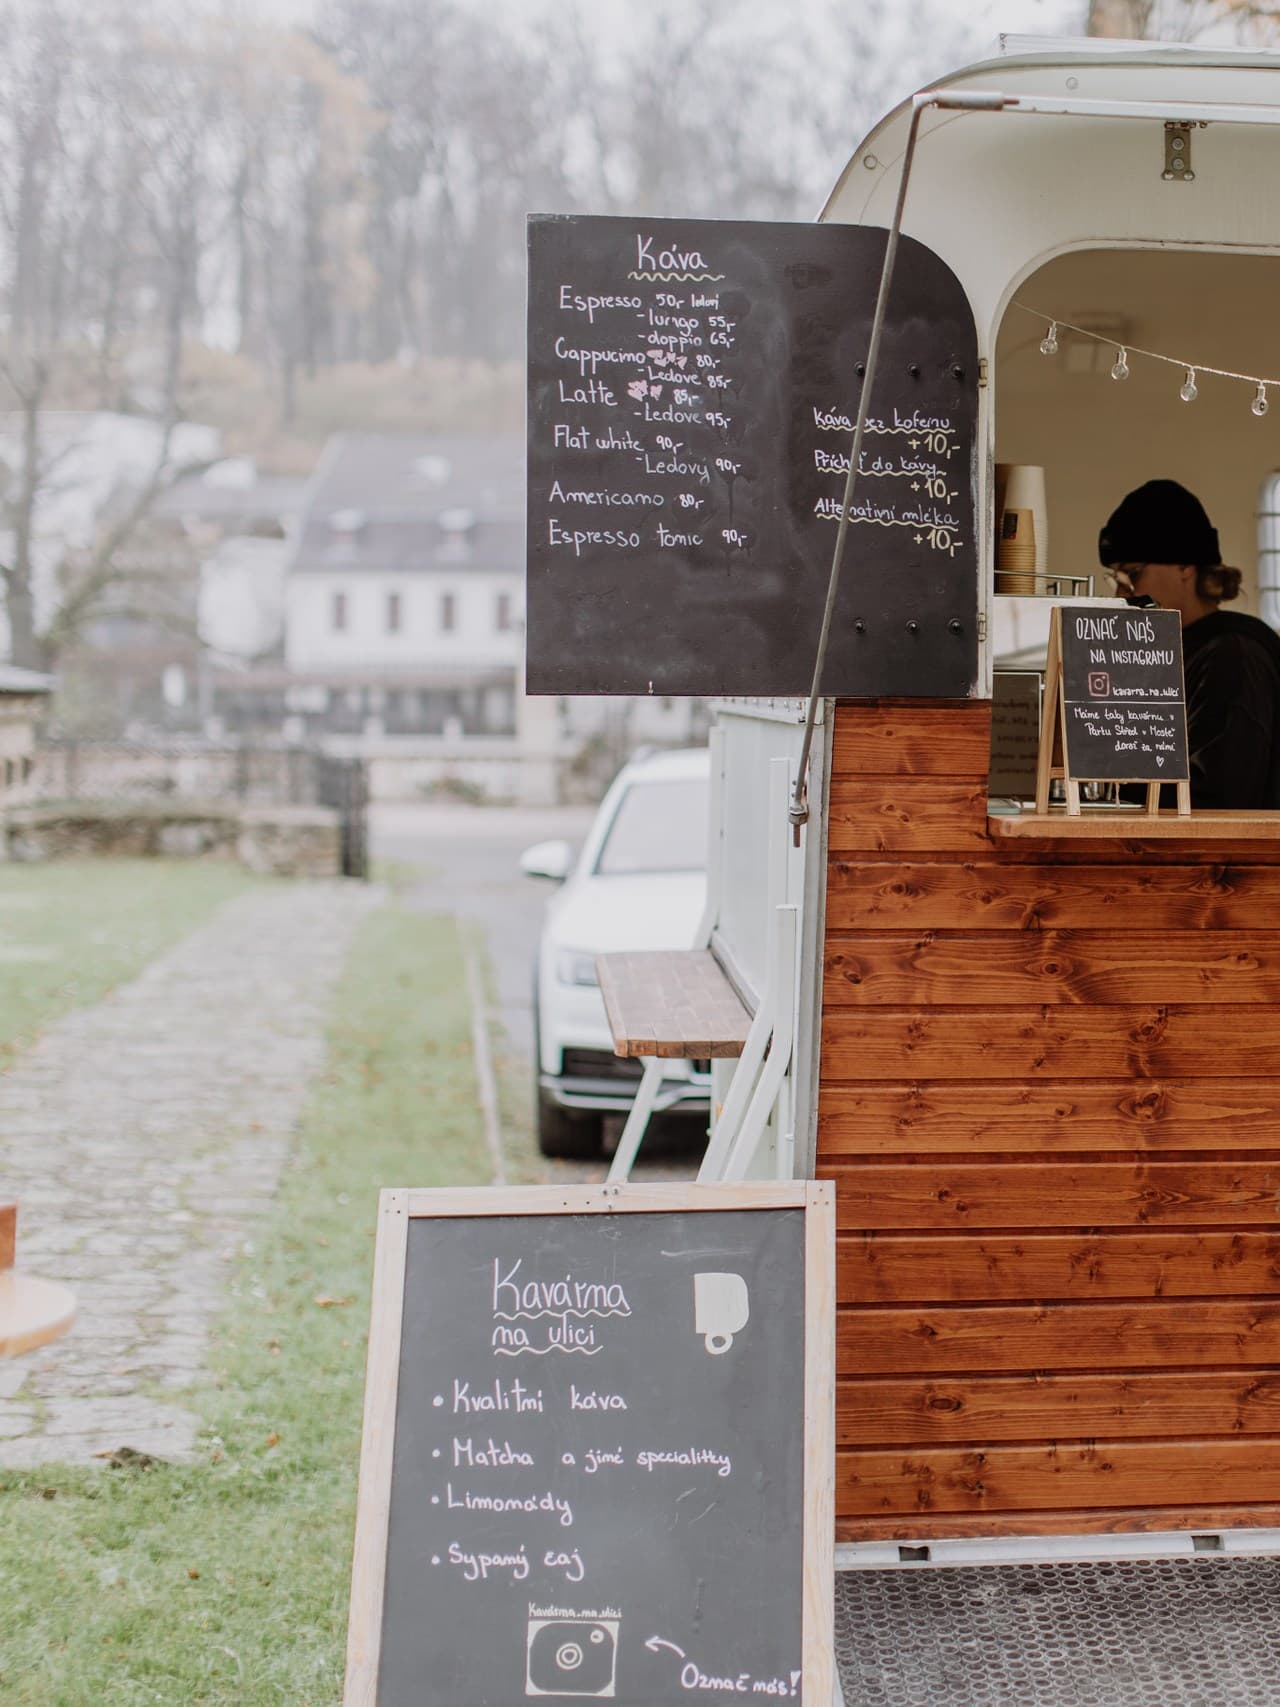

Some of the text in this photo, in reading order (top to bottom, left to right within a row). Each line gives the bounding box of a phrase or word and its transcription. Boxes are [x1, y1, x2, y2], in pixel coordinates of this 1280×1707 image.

[637, 234, 708, 270] Káva
[559, 285, 642, 324] Espresso
[708, 316, 736, 332] 55,-
[710, 332, 735, 348] 65,-
[696, 354, 721, 368] 80,-
[559, 379, 700, 407] Latte 85,-
[707, 375, 733, 389] 85,-
[705, 412, 732, 429] 95,-
[813, 406, 951, 429] Káva ez kofeinu
[554, 424, 684, 454] Flat white 90,-
[715, 458, 742, 474] 90,-
[814, 449, 937, 480] Příchť do kávy
[548, 480, 705, 509] Americano 80,-
[813, 497, 960, 525] Altenativní mléka
[548, 519, 748, 557] Espresso tonic 90,-
[1075, 615, 1119, 640] OZNAČ
[1090, 649, 1174, 666] NA INSTAGRAMU
[493, 1258, 630, 1311] Kavárna
[492, 1312, 596, 1346] na ulici
[452, 1379, 627, 1413] Kvalitní káva
[453, 1437, 732, 1477] Matcha a jiné specialitky
[447, 1482, 573, 1526] Limonády
[447, 1541, 585, 1582] Sypaný čaj
[681, 1663, 802, 1697] Označ nás!
